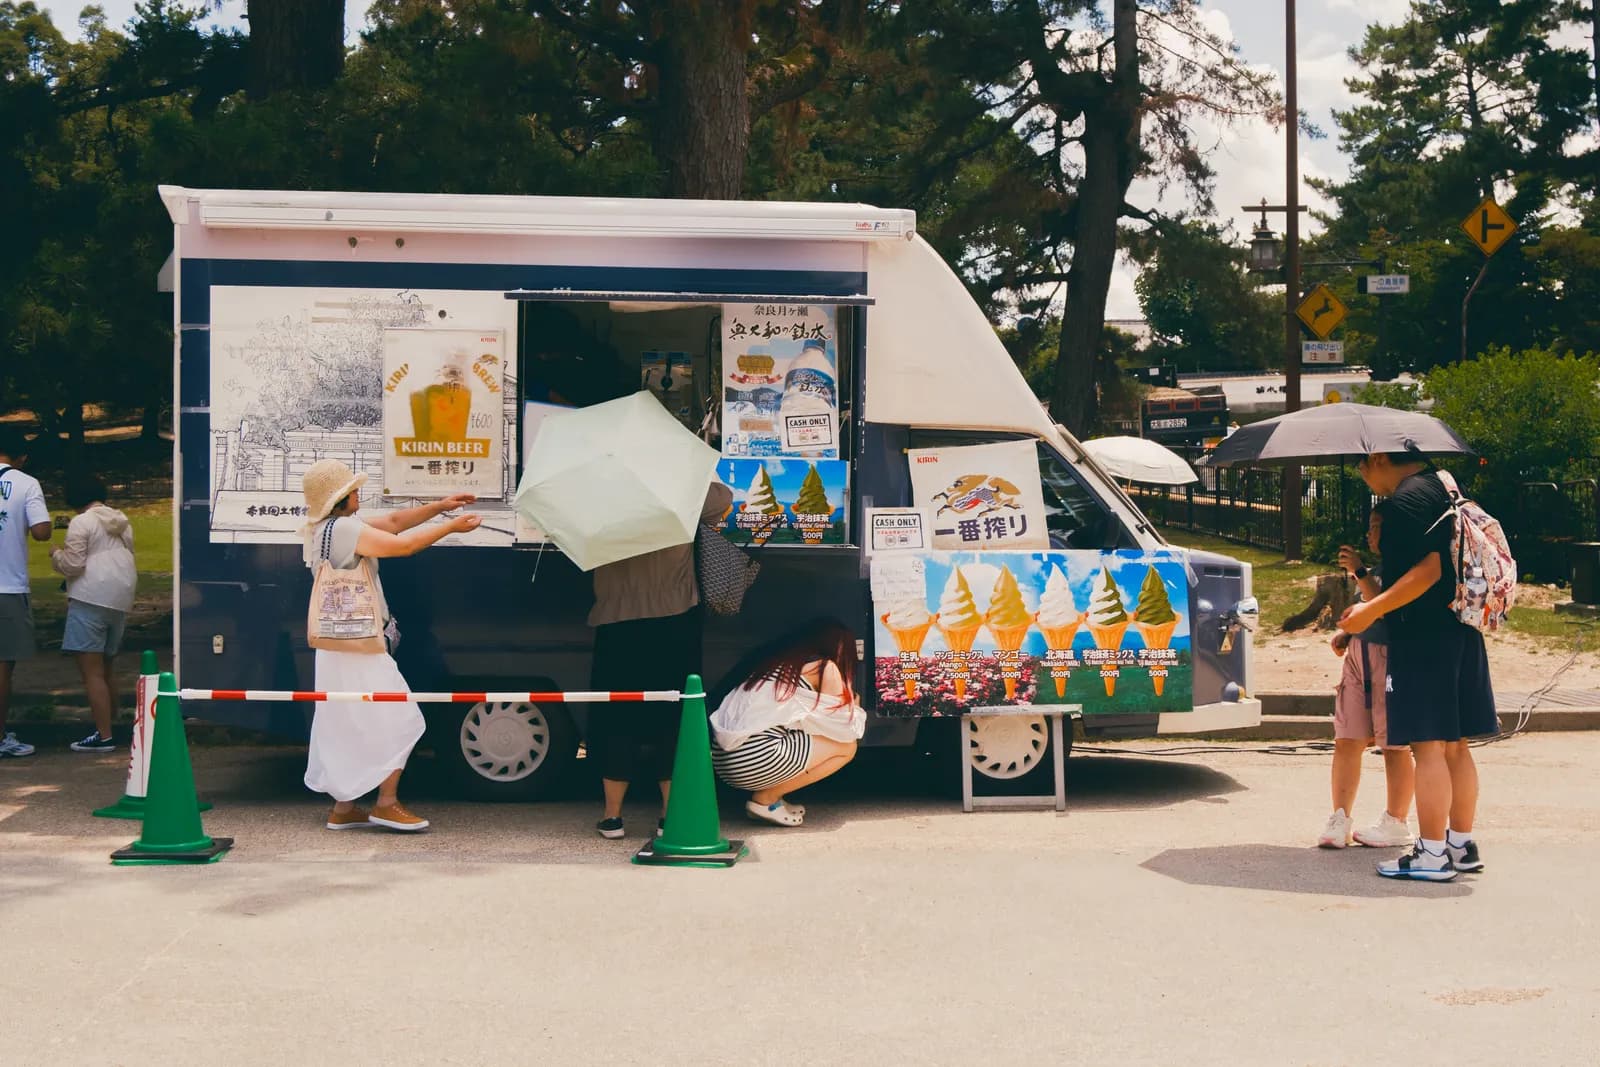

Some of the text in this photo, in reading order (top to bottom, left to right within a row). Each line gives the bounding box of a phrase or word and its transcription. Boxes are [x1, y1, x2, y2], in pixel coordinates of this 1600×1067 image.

[789, 417, 827, 427] CASH ONLY
[402, 441, 484, 454] KIRIN BEER
[917, 456, 938, 464] KIRIN
[411, 460, 474, 475] 一番搾り
[796, 513, 829, 522] 宇治抹茶
[875, 518, 917, 527] CASH ONLY
[935, 514, 1028, 542] 一番搾り
[802, 532, 822, 540] 500円
[900, 651, 919, 662] 生乳
[935, 651, 984, 660] マンゴーミックス
[992, 650, 1029, 659] マンゴー
[1046, 649, 1074, 660] 北海道
[1082, 649, 1136, 659] 宇治抹茶ミックス
[1138, 649, 1177, 659] 宇治抹茶
[938, 661, 962, 669] Mango
[999, 660, 1023, 668] Mango
[950, 671, 970, 679] 500円
[1001, 671, 1021, 679] 500円
[1050, 670, 1070, 678] 500円
[1100, 670, 1120, 678] 500円
